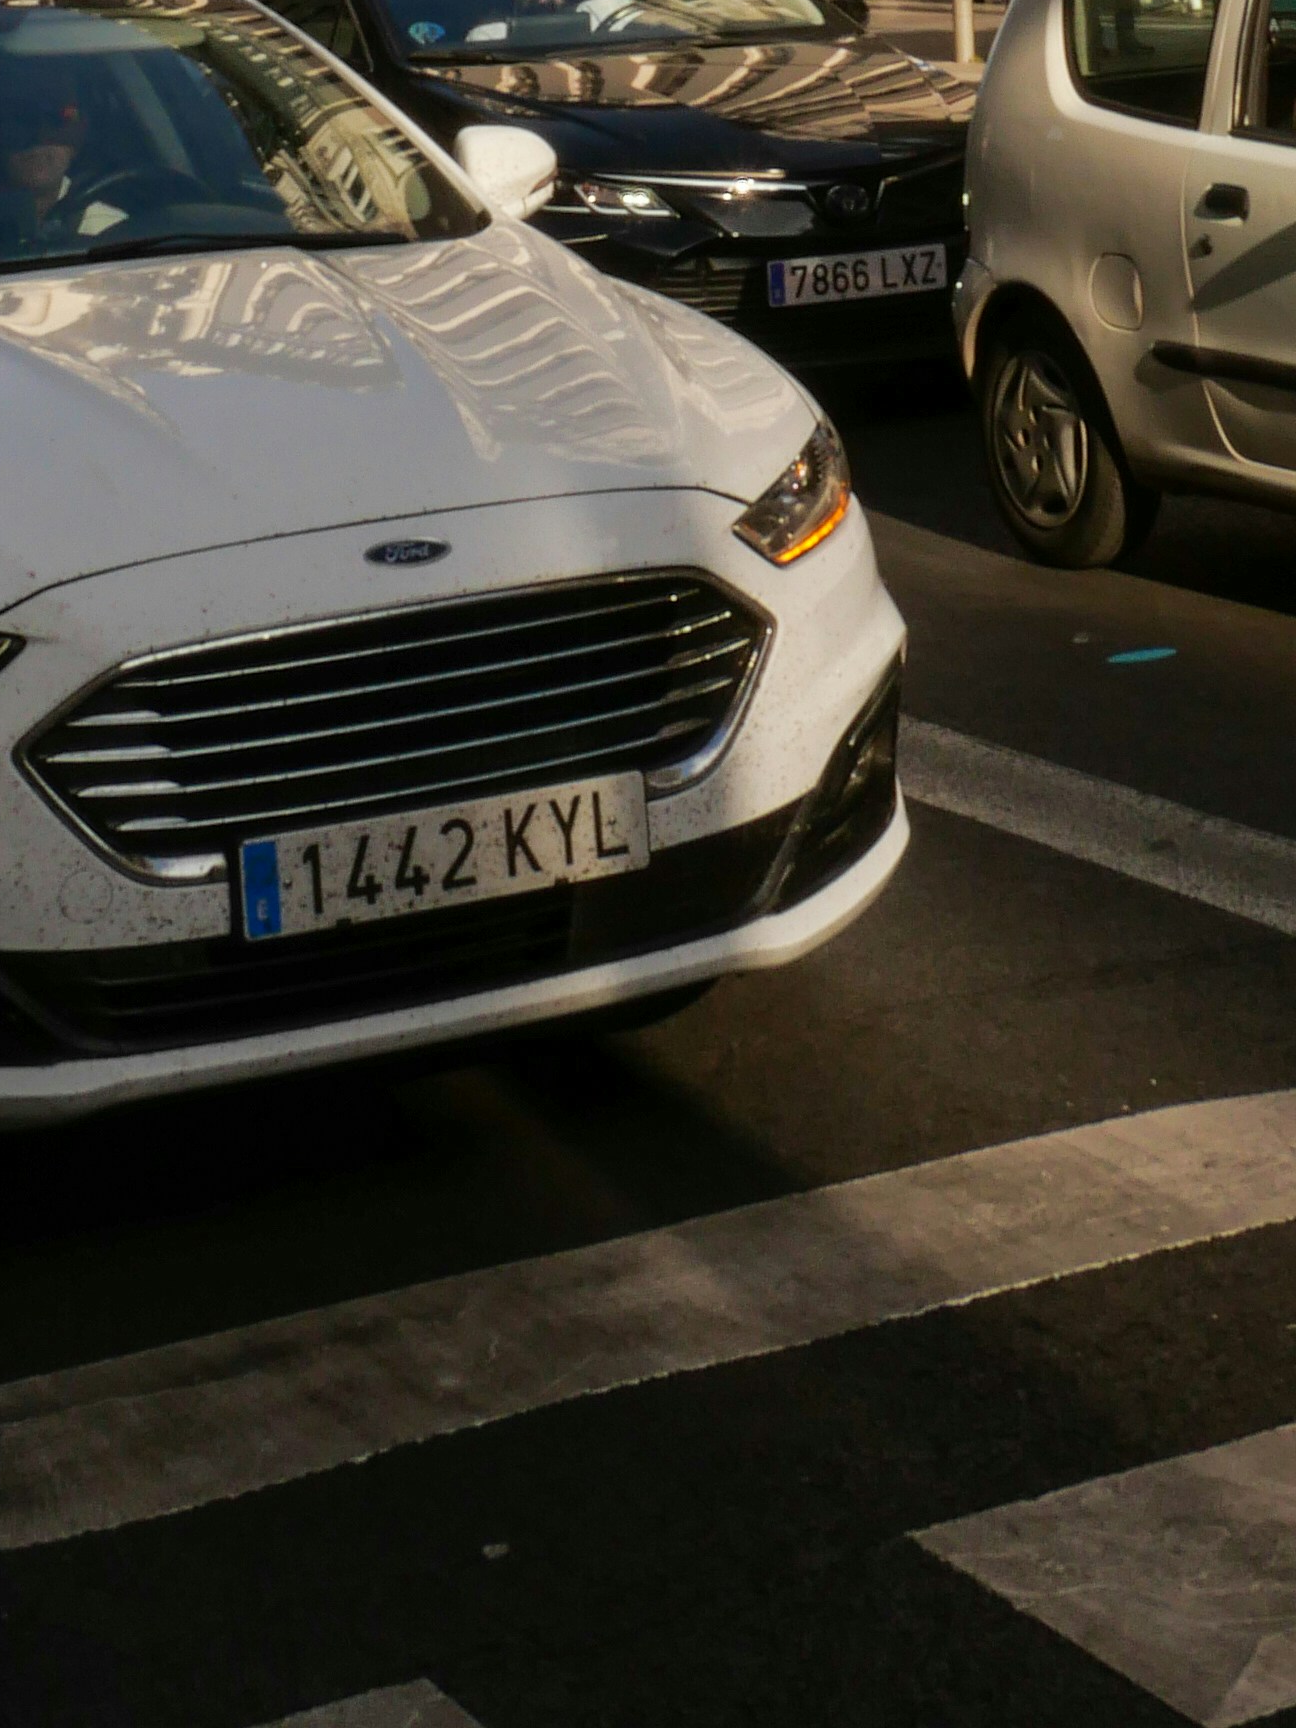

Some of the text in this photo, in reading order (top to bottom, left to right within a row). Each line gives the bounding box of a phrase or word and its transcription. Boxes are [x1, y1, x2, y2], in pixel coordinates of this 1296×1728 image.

[791, 251, 937, 299] 7866 LXZ
[302, 790, 631, 915] 1442 KYL
